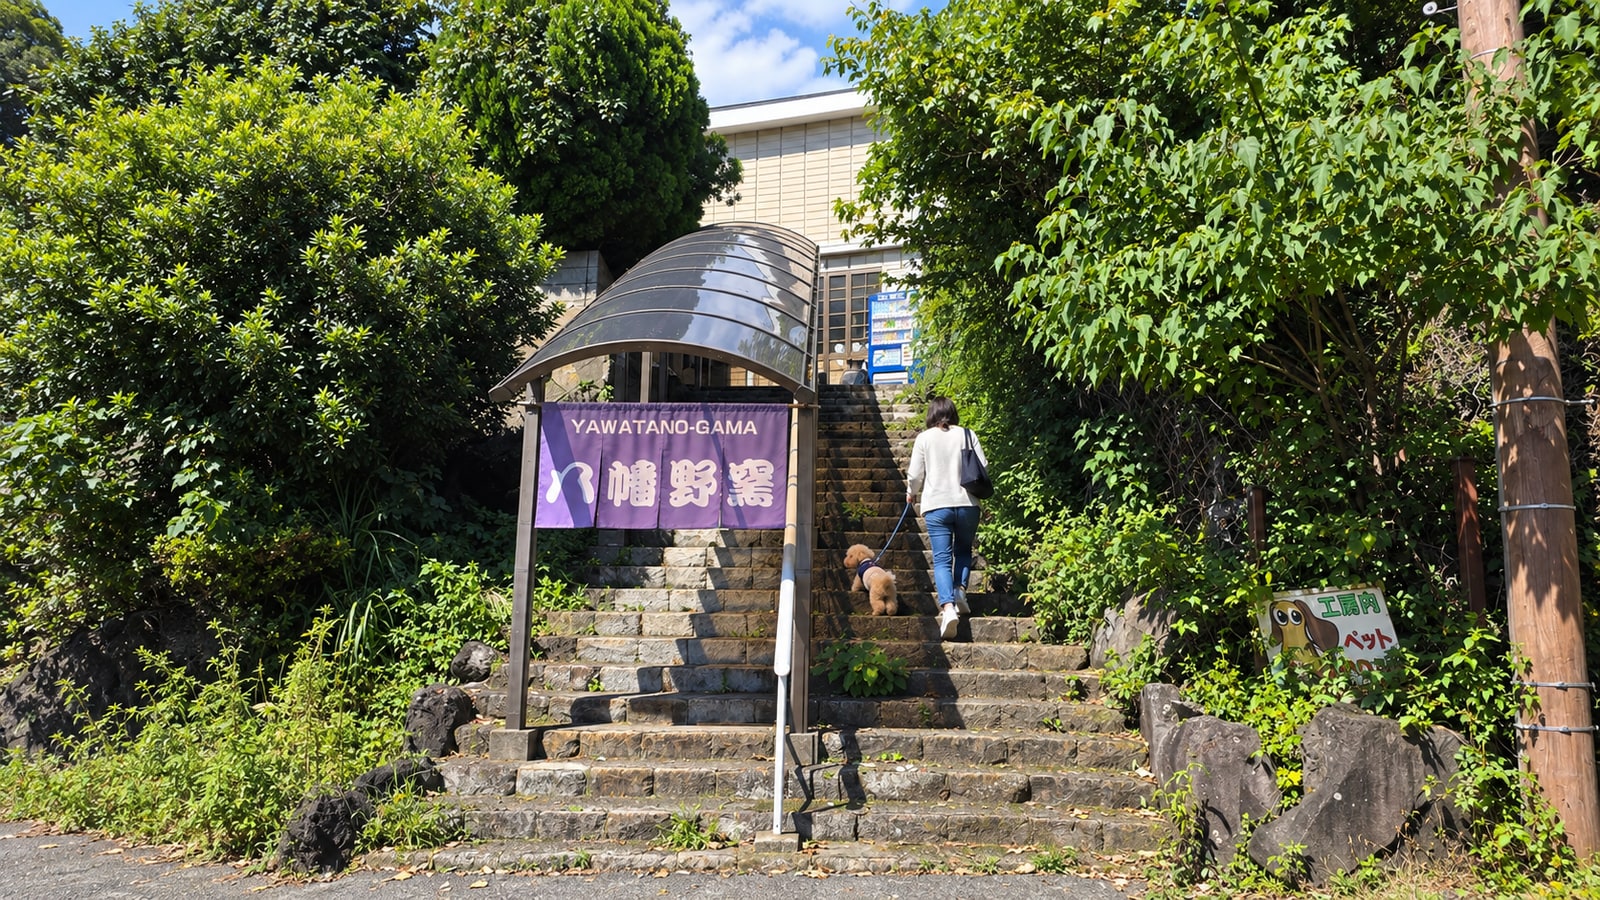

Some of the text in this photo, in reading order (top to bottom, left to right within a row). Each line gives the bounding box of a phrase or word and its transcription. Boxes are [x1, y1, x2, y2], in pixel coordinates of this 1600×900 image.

[571, 418, 758, 435] YAWATANO-GAMA
[545, 458, 775, 508] 八幡野窯
[1317, 591, 1381, 618] 工房内
[1344, 628, 1393, 650] ペット
